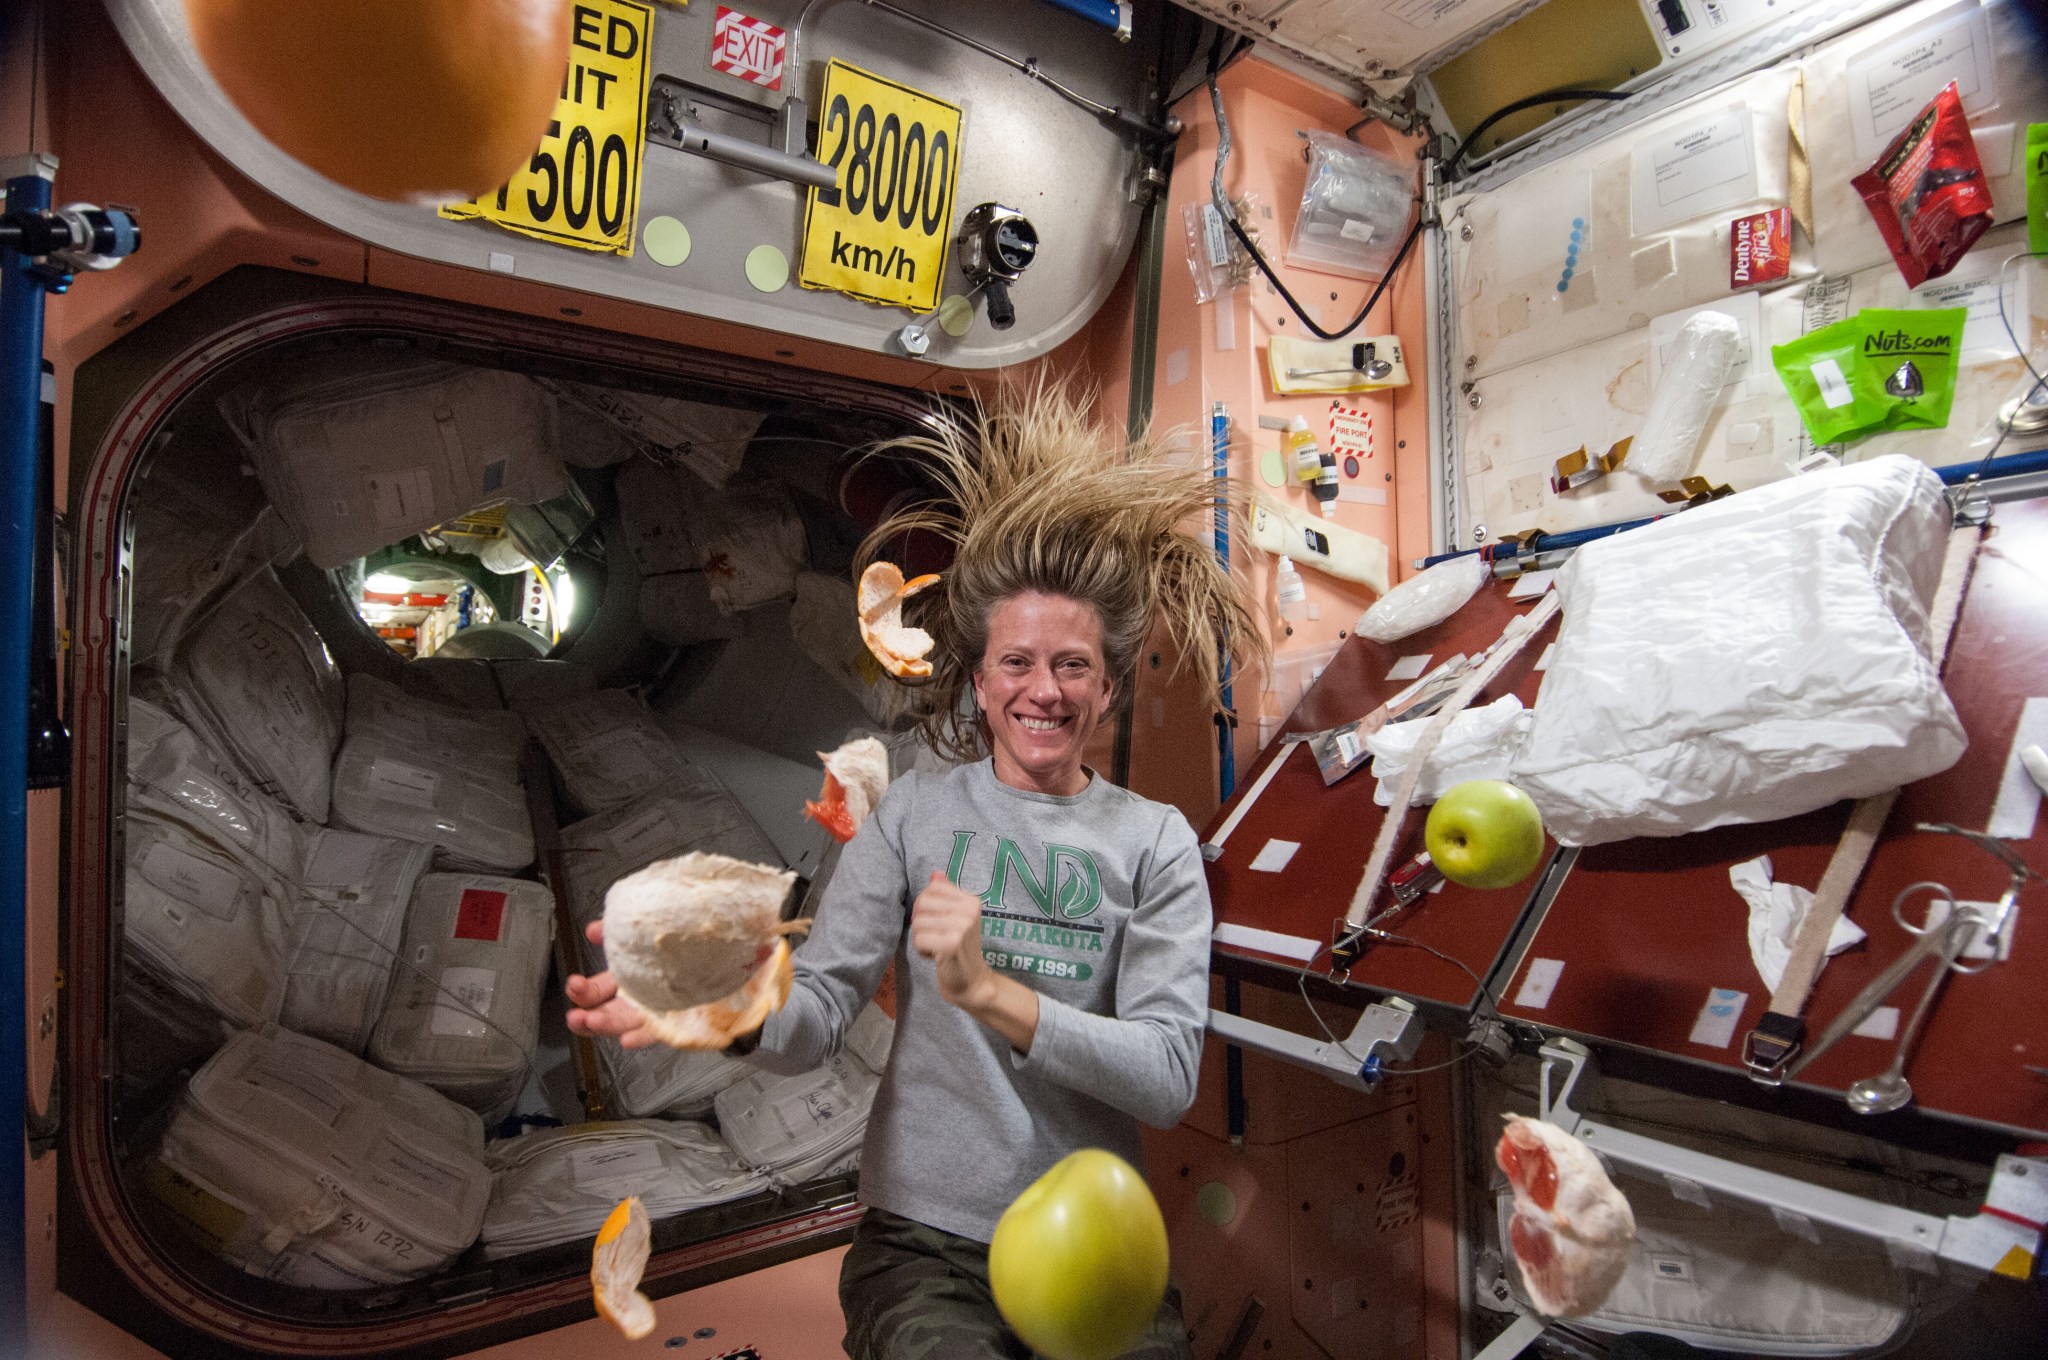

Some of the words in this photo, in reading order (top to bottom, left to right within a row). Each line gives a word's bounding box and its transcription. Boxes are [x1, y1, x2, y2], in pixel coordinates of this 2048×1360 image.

[724, 20, 775, 70] EXIT
[816, 94, 949, 236] 28000
[830, 231, 916, 282] km/h
[1734, 220, 1750, 283] Dentyne
[1863, 329, 1951, 352] Nuts.com
[1336, 427, 1350, 436] FIRE
[1351, 430, 1368, 439] PORT
[945, 831, 1103, 919] UND
[987, 910, 1061, 927] UNIVERSITY
[1068, 923, 1082, 931] OF
[1011, 924, 1104, 952] DAKOTA
[1012, 955, 1035, 970] OF
[1036, 958, 1077, 979] 1994
[341, 1212, 371, 1234] S/N
[373, 1229, 414, 1261] 1272
